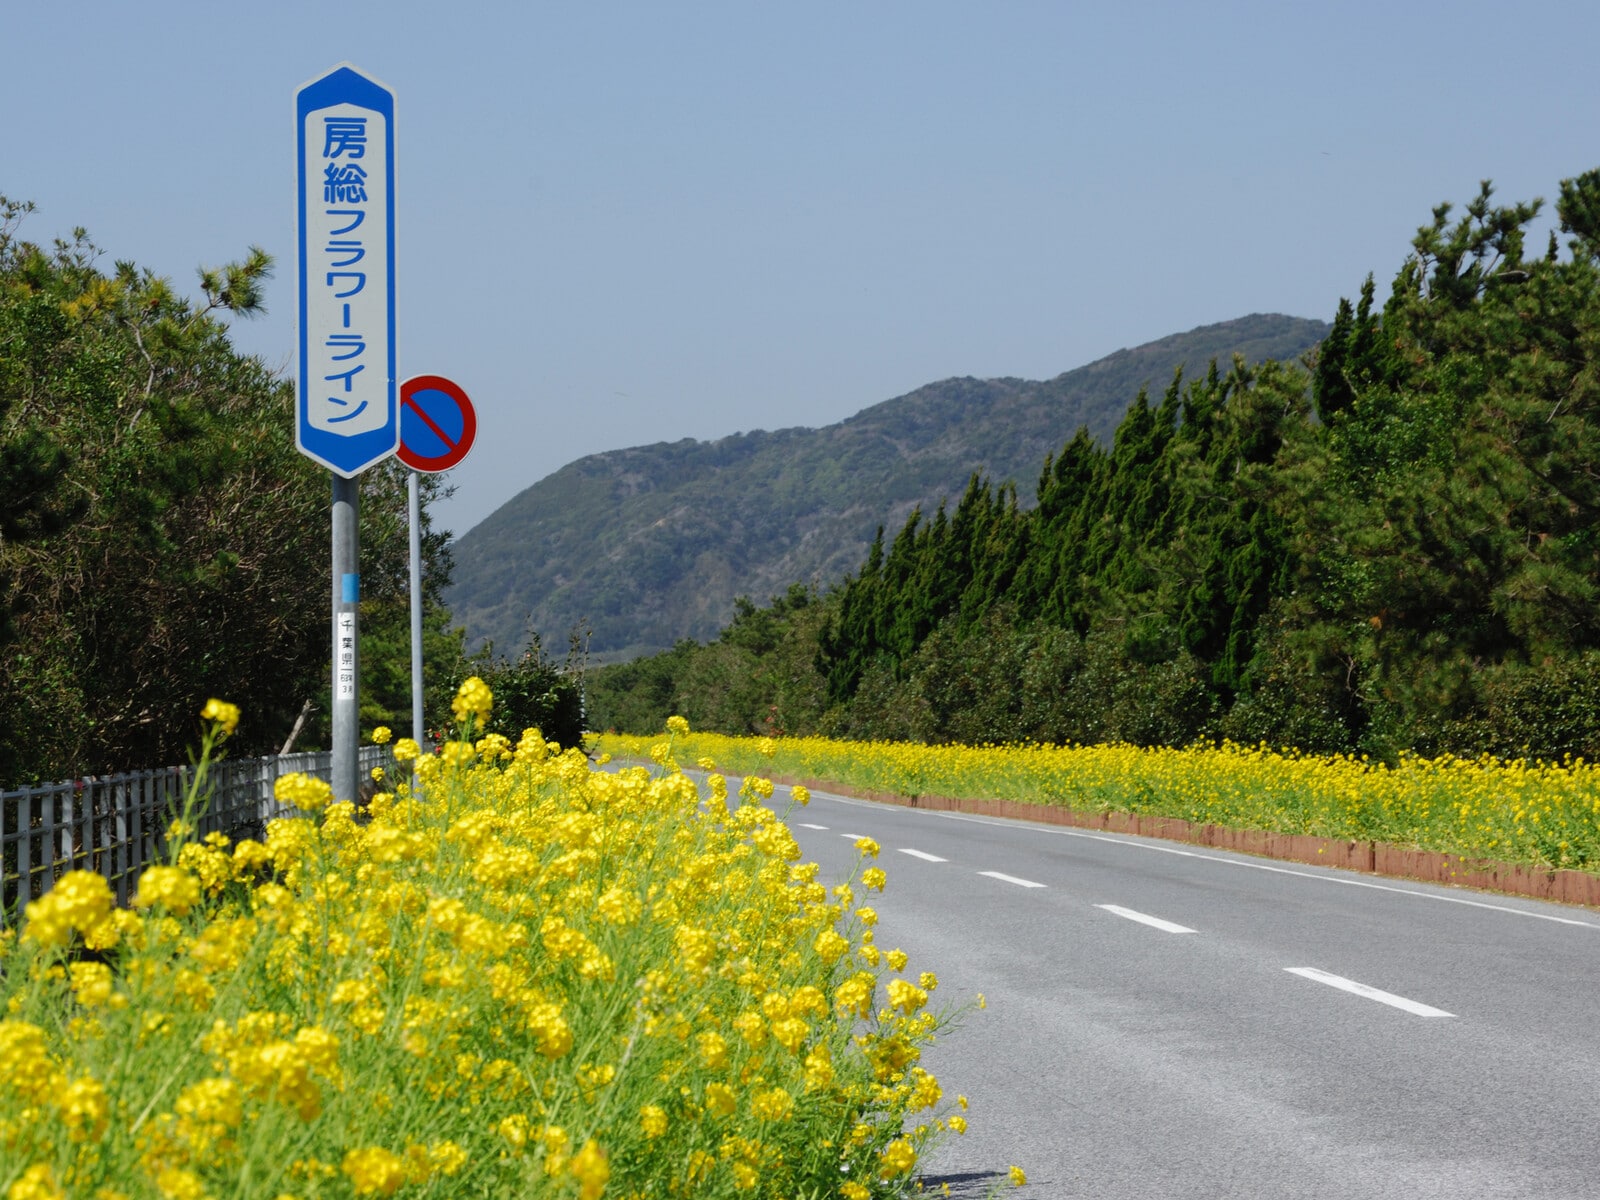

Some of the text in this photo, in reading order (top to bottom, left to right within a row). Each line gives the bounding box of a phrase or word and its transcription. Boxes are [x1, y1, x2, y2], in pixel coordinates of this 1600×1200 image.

[323, 117, 368, 423] 房総フラワーライン
[341, 619, 353, 665] 千葉県
